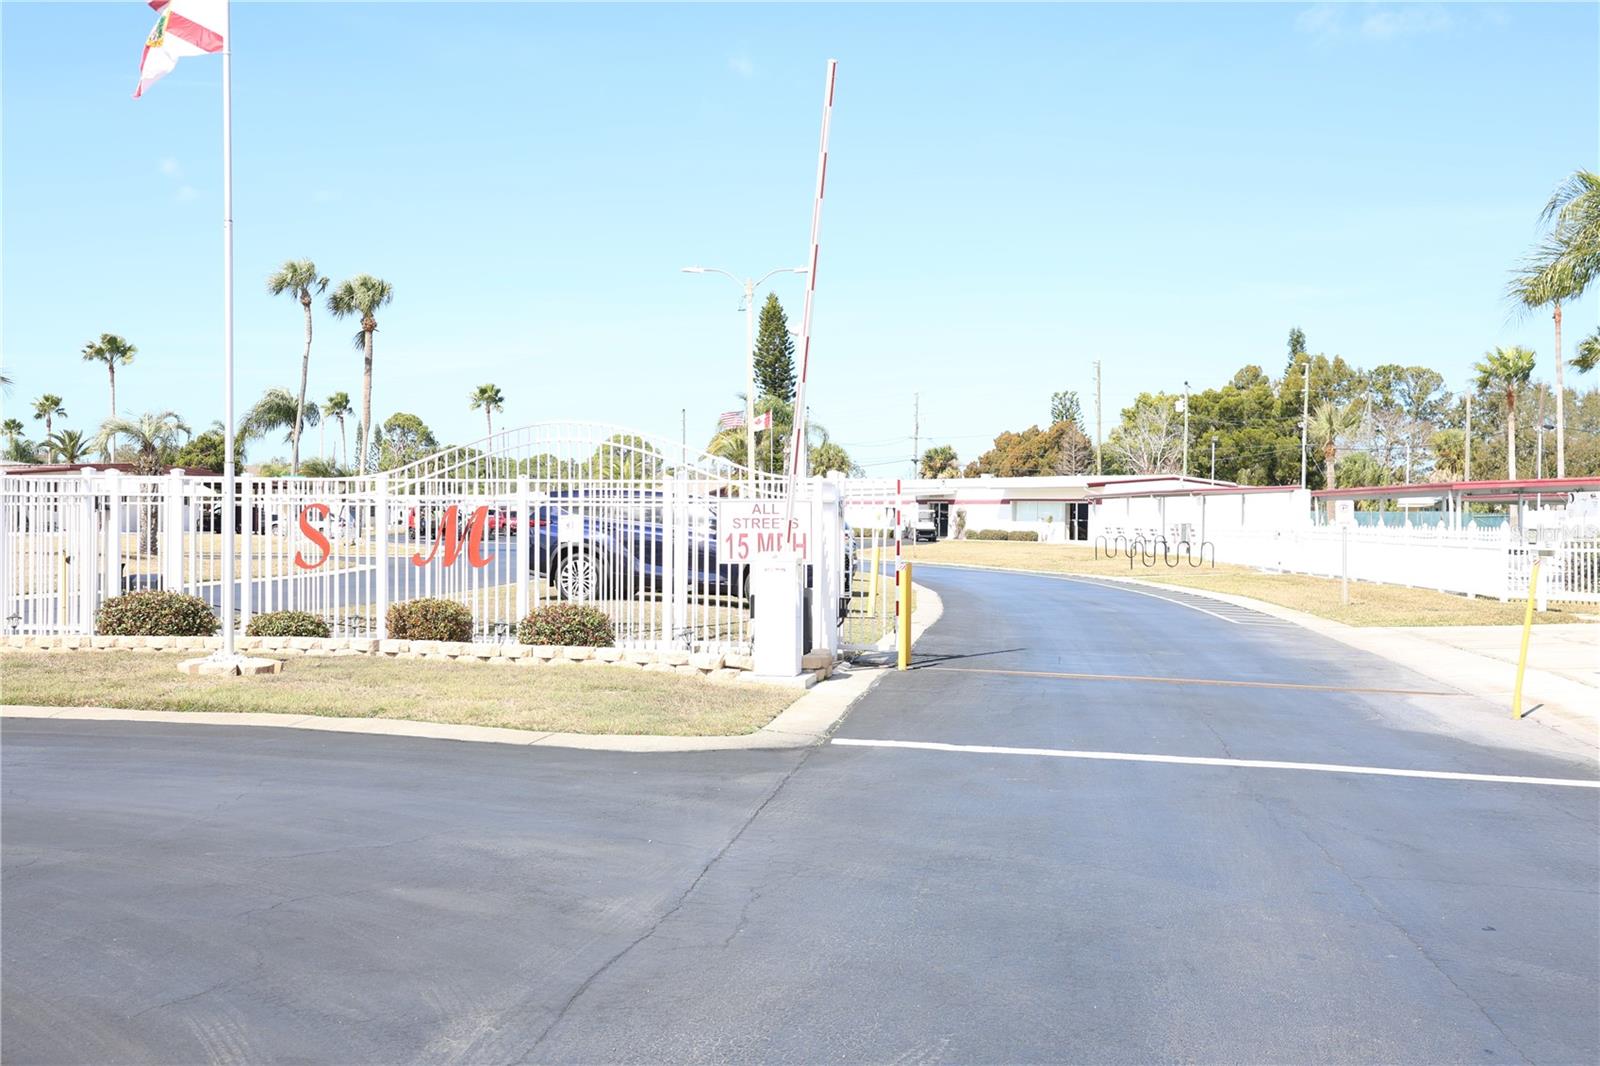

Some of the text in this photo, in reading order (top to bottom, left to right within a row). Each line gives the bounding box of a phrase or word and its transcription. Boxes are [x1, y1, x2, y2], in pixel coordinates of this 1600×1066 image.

[751, 503, 780, 515] ALL
[732, 517, 799, 529] STREES
[294, 503, 495, 569] S M
[725, 532, 749, 560] 15
